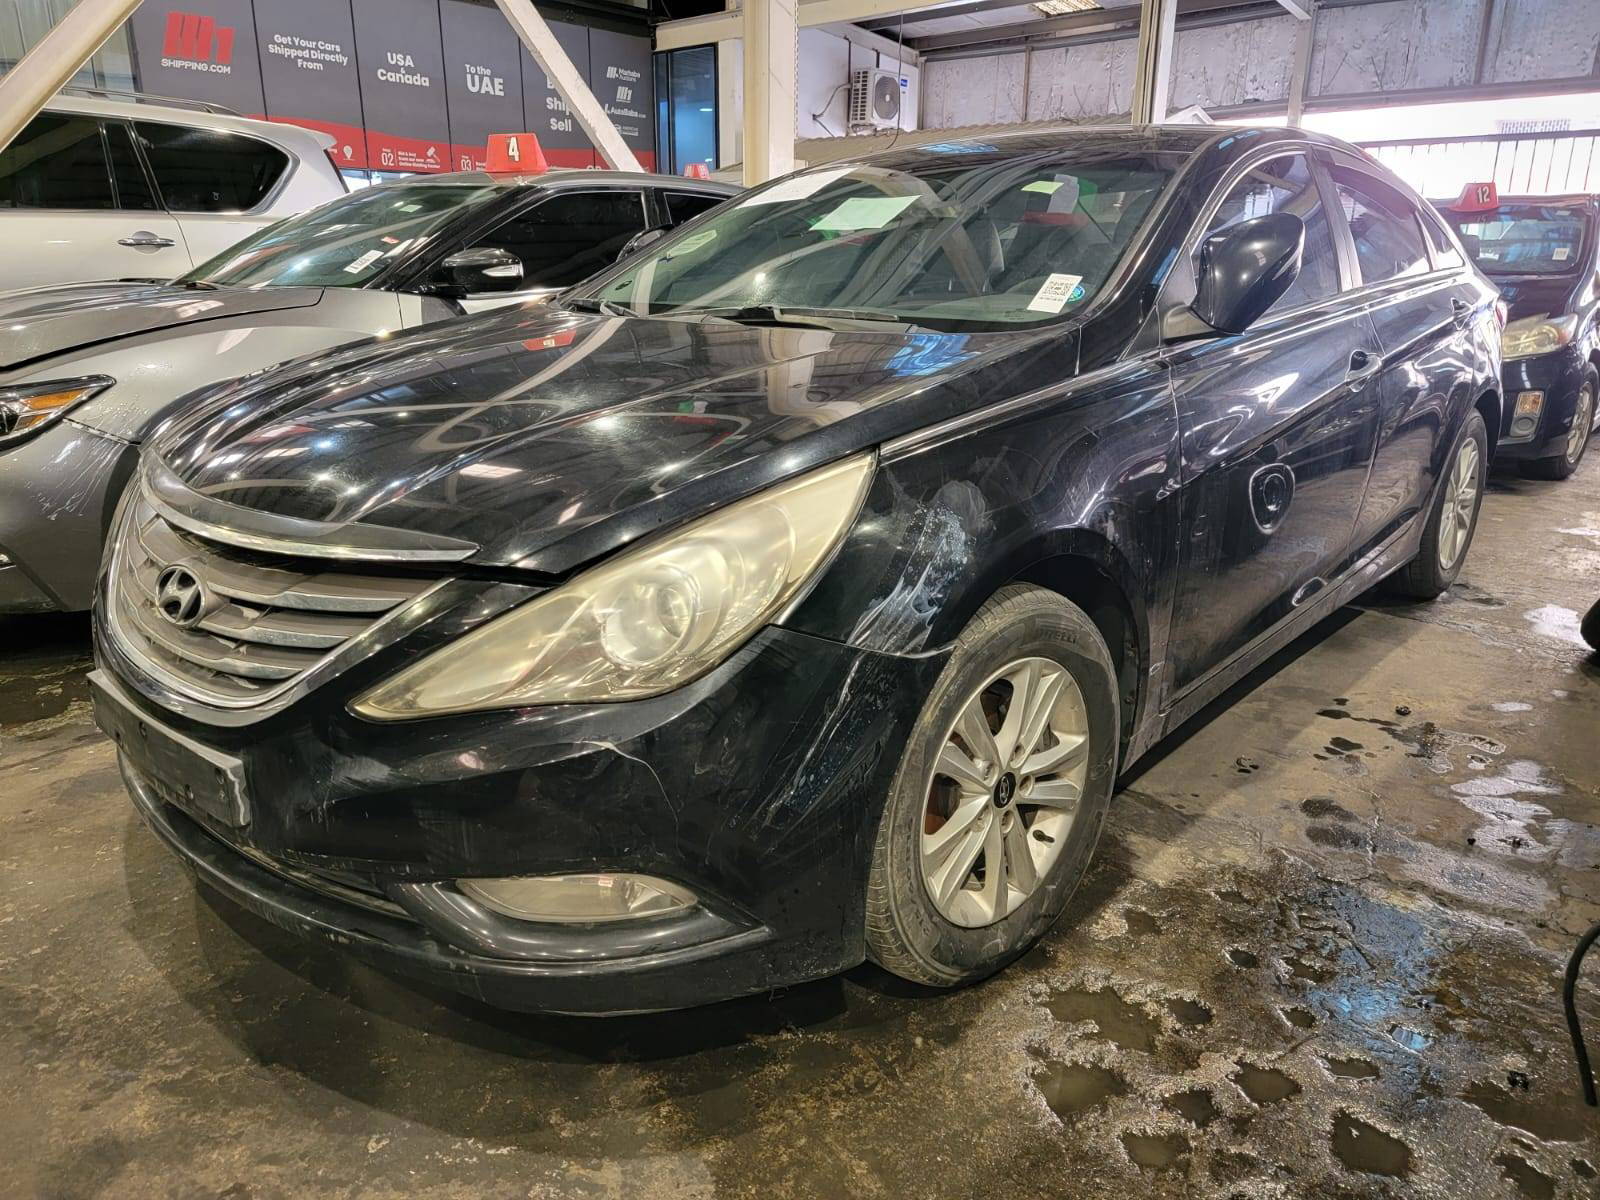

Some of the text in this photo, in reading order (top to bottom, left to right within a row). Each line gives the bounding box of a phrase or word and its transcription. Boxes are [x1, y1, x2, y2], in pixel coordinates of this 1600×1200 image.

[273, 34, 341, 53] Get Your Cars
[268, 44, 349, 67] Shipped Directly
[387, 52, 415, 68] USA
[160, 58, 231, 74] SHIPPING.COM
[297, 58, 324, 71] From
[464, 63, 492, 76] To the
[377, 68, 430, 87] Canada
[466, 73, 505, 97] UAE
[550, 117, 572, 132] Sell
[508, 136, 520, 162] 4
[381, 152, 395, 166] 02
[460, 159, 472, 171] 03
[1477, 186, 1491, 204] 12
